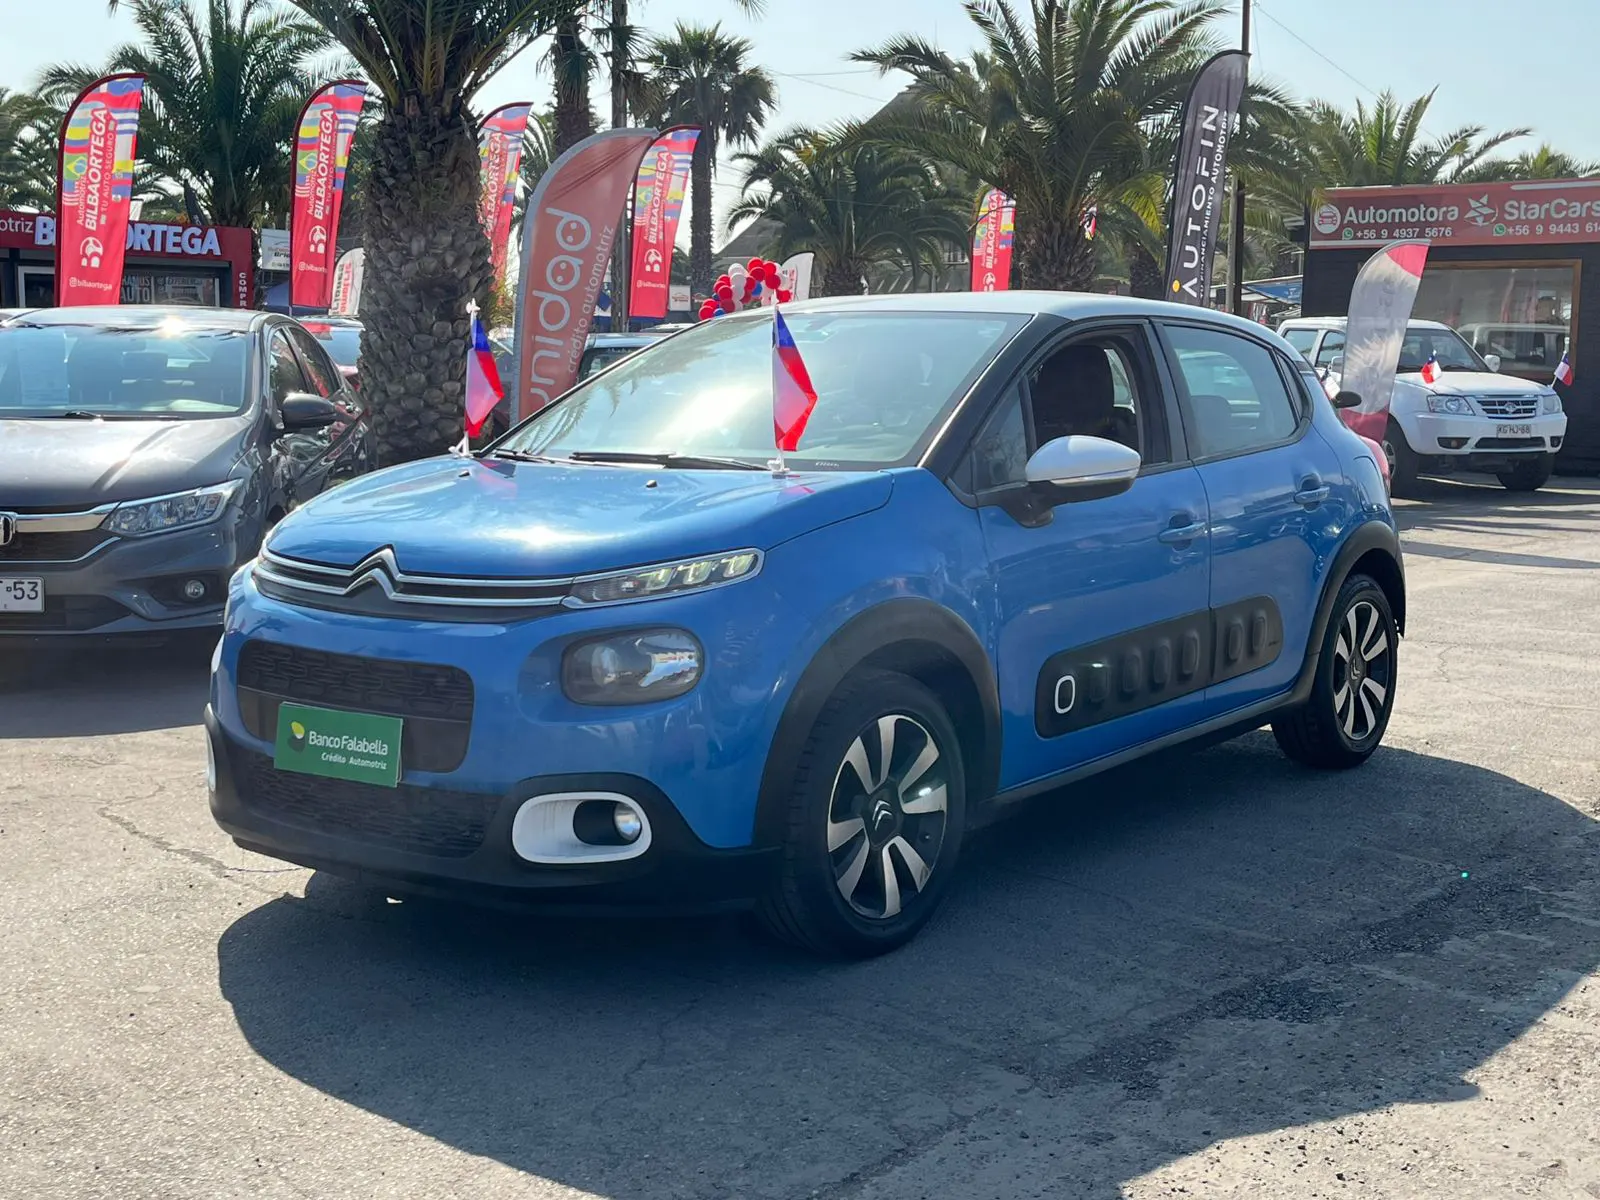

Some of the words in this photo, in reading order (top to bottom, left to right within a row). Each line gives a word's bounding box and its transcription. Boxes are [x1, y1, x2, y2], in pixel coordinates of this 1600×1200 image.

[85, 108, 108, 231] BILBAORTEGA
[314, 109, 334, 221] BILBAORTEGA
[648, 151, 670, 244] BILBAORTEGA
[1181, 105, 1219, 298] AUTOFIN
[985, 193, 999, 269] BILBAORTEGA
[1343, 203, 1460, 224] Automotora
[1503, 198, 1600, 221] StarCars
[1356, 228, 1376, 240] +56
[1381, 228, 1388, 239] 9
[1393, 227, 1420, 239] 4937
[1424, 226, 1452, 238] 5676
[1507, 224, 1530, 236] +56
[1535, 223, 1544, 235] 9
[1549, 222, 1580, 235] 9443
[568, 317, 588, 373] crédito
[581, 225, 614, 314] automotriz
[321, 752, 346, 764] Crédito
[349, 756, 387, 770] Automotriz
